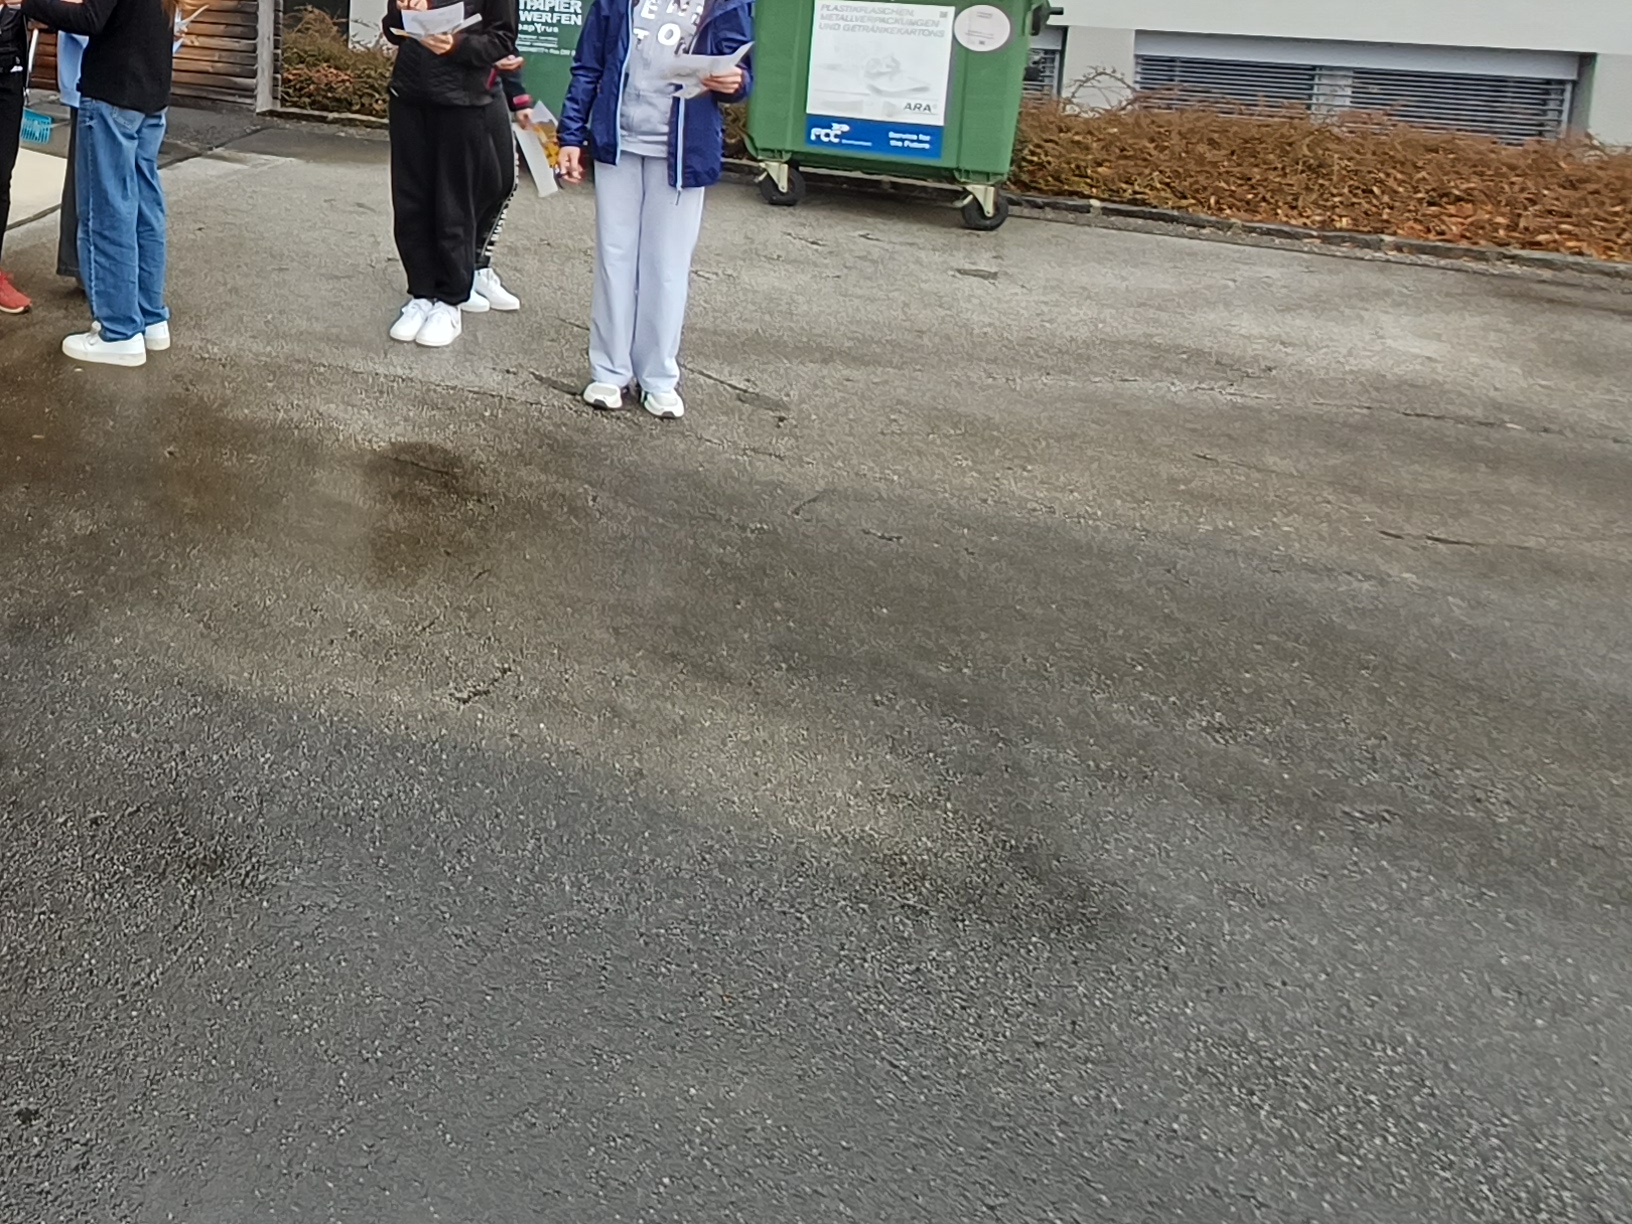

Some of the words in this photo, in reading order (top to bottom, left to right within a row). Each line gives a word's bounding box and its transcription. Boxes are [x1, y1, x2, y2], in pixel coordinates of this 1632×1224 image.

[518, 10, 583, 26] WERFEN
[818, 22, 841, 32] UND
[904, 102, 932, 113] ARA
[810, 127, 842, 144] FCC
